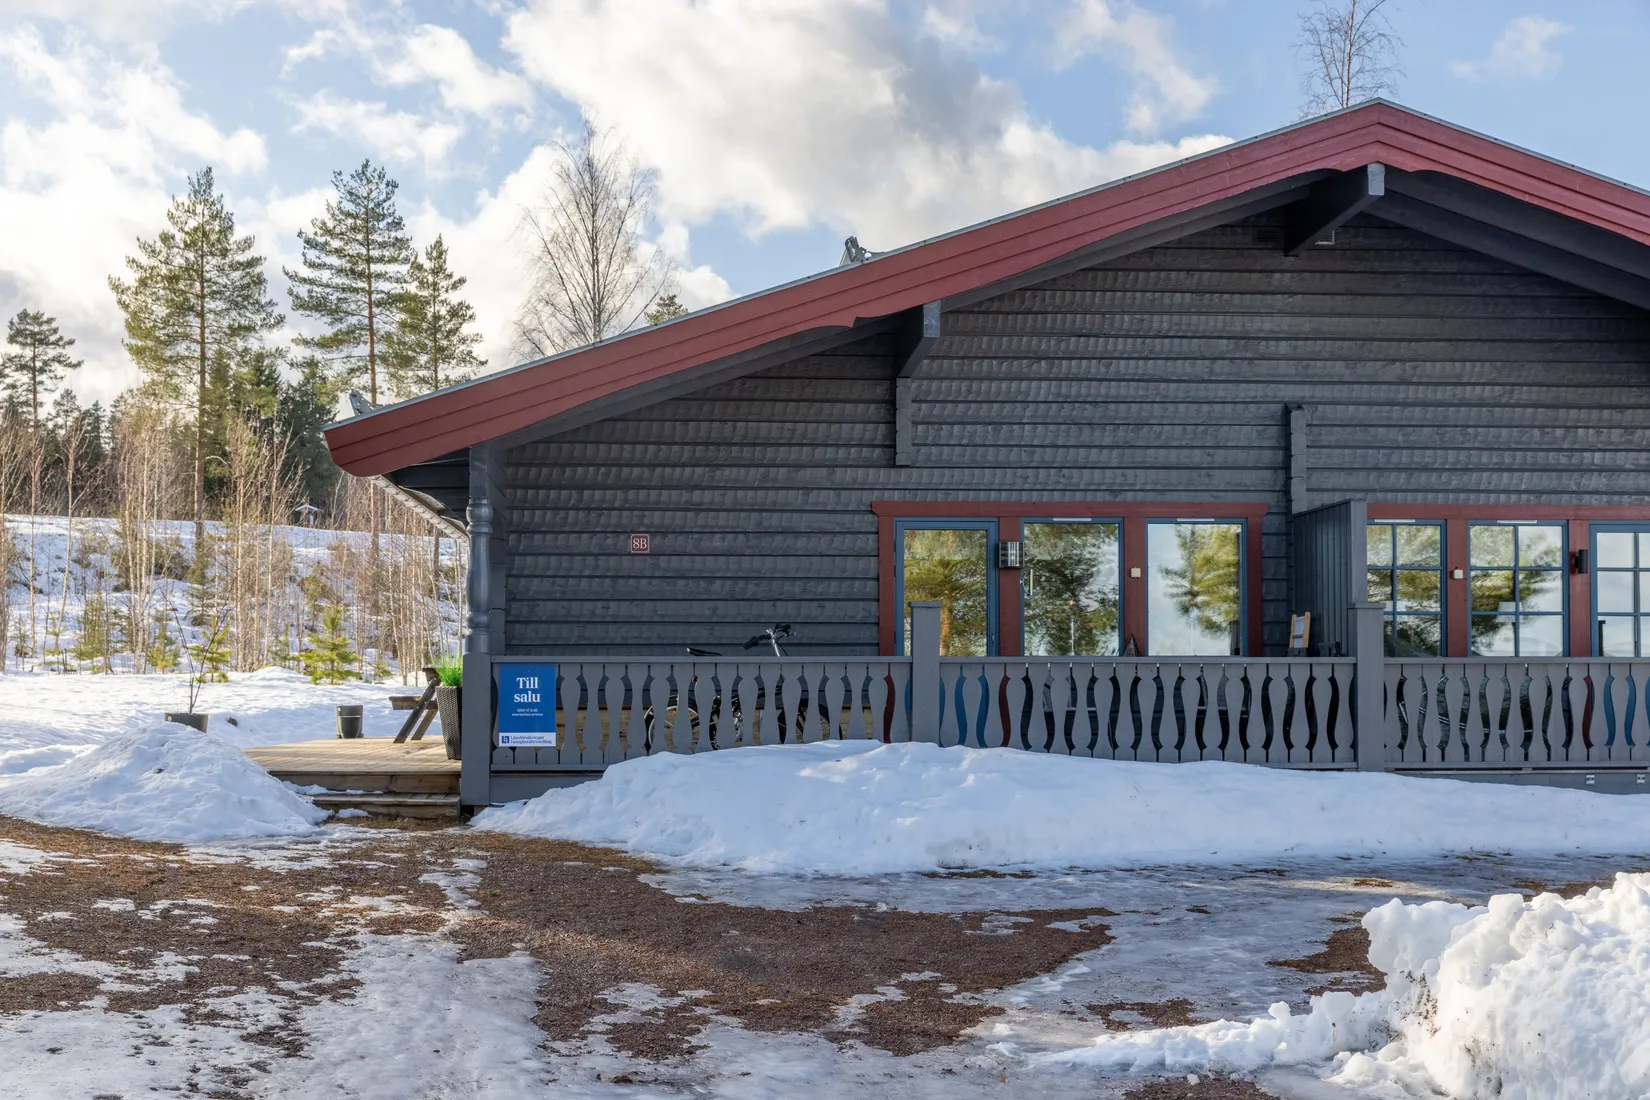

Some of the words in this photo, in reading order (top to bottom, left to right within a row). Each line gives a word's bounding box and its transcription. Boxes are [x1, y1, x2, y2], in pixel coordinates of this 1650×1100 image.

[632, 538, 647, 549] 8B
[516, 677, 538, 688] Till
[514, 691, 541, 702] salu
